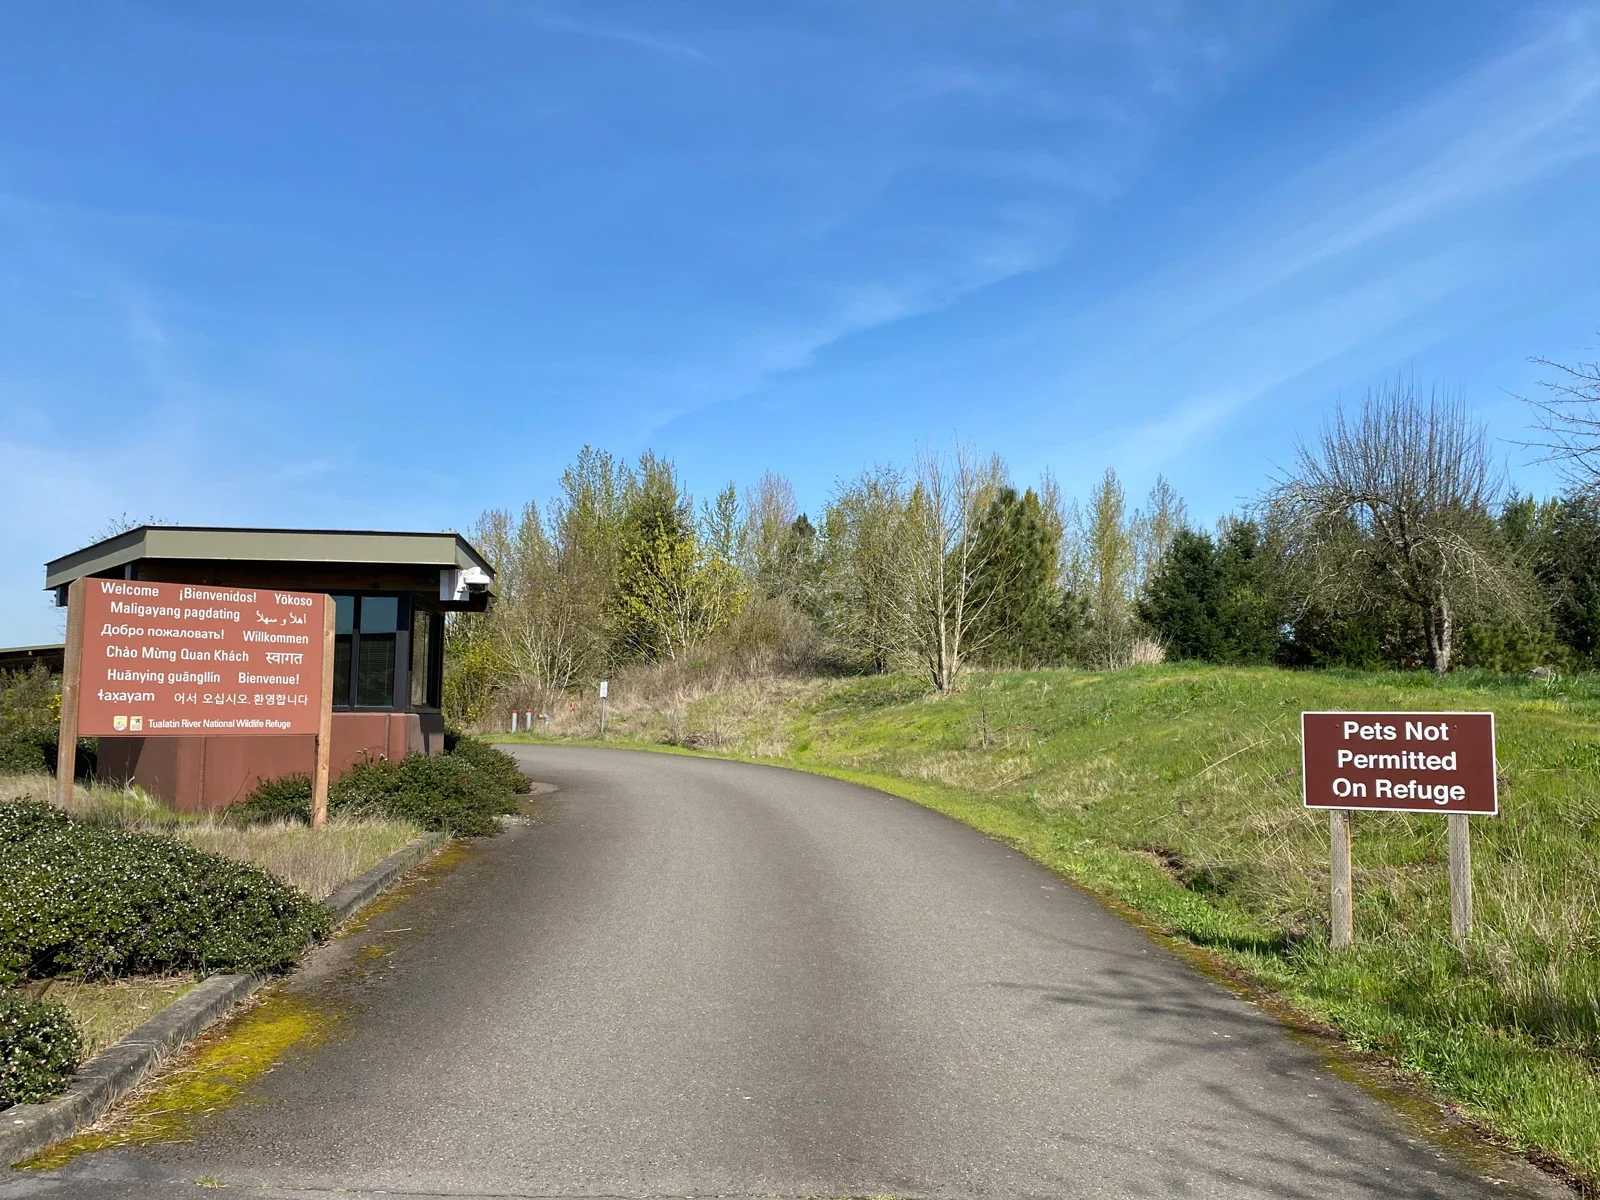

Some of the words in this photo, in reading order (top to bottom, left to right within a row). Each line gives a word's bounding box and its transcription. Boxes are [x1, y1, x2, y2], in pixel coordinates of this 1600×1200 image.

[101, 582, 159, 597] Welcome
[179, 587, 257, 603] ¡Bienvenidos!
[274, 594, 313, 606] Yōkoso
[110, 602, 180, 619] Maligayang
[184, 606, 240, 622] pagdating
[101, 624, 143, 637] Добро
[147, 627, 225, 640] пожаловать!
[243, 631, 308, 644] Willkommen
[106, 646, 137, 659] Chào
[180, 649, 210, 660] Quan
[214, 650, 249, 662] Khách
[265, 652, 303, 665] स्वागत
[239, 672, 300, 685] Bienvenue!
[174, 693, 197, 705] 어서
[253, 694, 308, 706] 환영합니다
[148, 719, 180, 729] Tualatin
[182, 719, 203, 728] River
[203, 719, 235, 728] National
[235, 720, 264, 728] Wildlife
[265, 720, 291, 729] Refuge
[1344, 721, 1396, 741] Pets
[1406, 722, 1449, 741] Not
[1337, 750, 1457, 770] Permitted
[1333, 778, 1366, 797] On
[1376, 779, 1465, 805] Refuge
